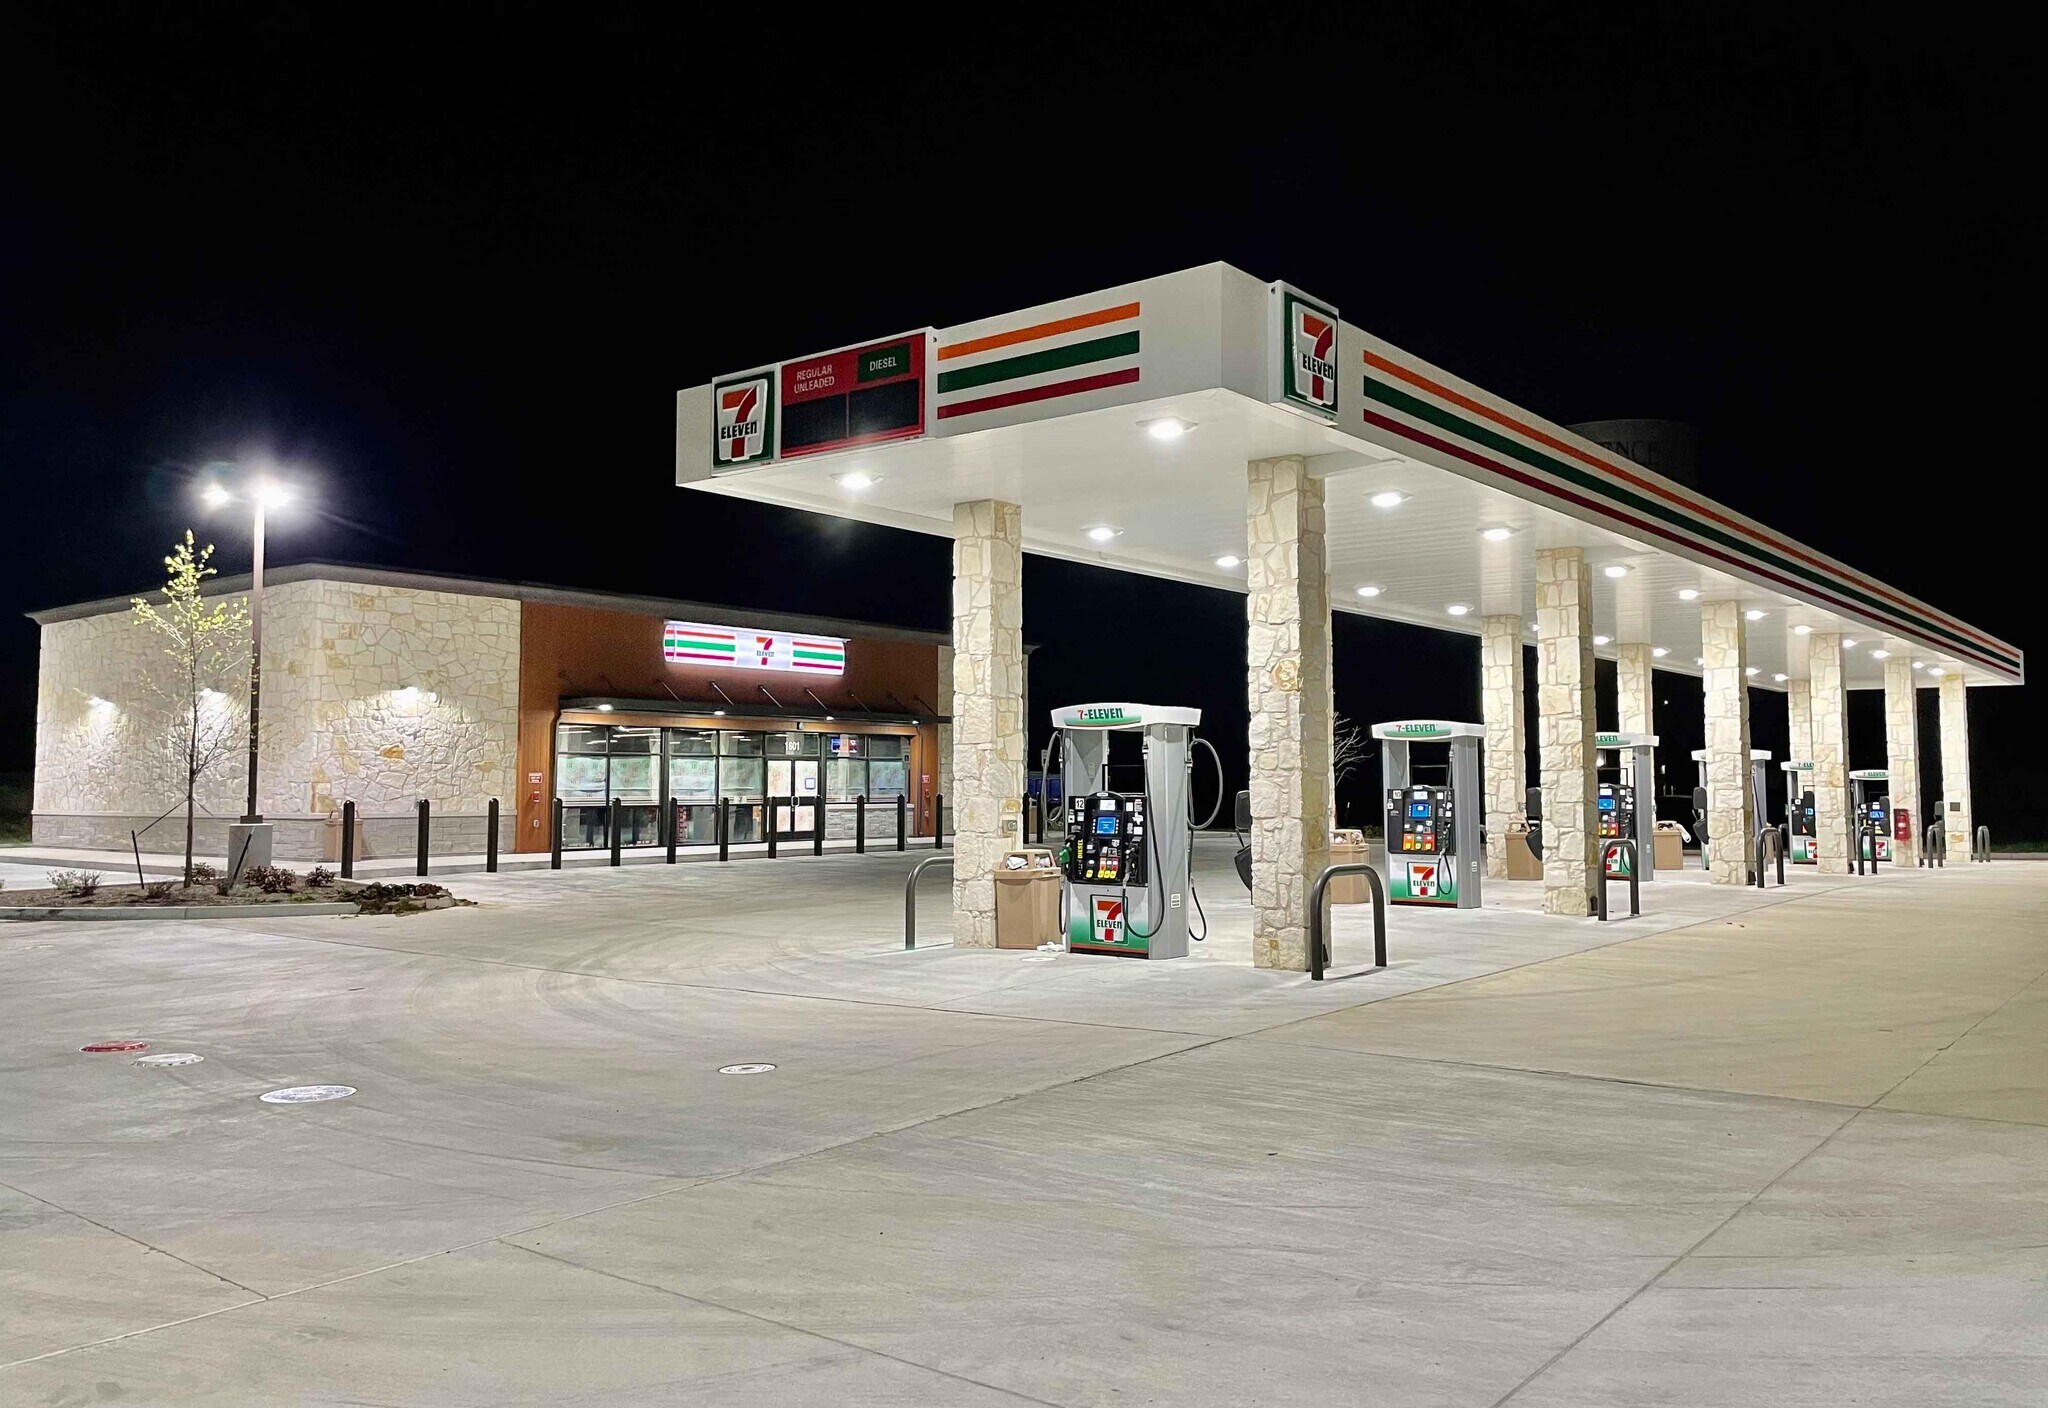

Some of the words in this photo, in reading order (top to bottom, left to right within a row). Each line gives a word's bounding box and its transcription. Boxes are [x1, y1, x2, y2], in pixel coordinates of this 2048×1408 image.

[869, 356, 898, 371] DIESEL
[1302, 313, 1333, 401] 7
[796, 364, 833, 381] REGULAR
[1302, 353, 1334, 380] ELEVEN
[793, 376, 835, 394] UNLEADED
[721, 421, 758, 439] ELEVEN
[722, 385, 757, 458] 7
[756, 636, 773, 666] 7
[1077, 708, 1124, 720] 7-ELEVEN
[1396, 724, 1436, 733] 7-ELEVEN
[785, 741, 800, 751] 1601
[1075, 799, 1084, 808] 12
[1413, 866, 1435, 896] 7
[1096, 920, 1122, 930] ELEVEN
[1097, 900, 1122, 941] 7
